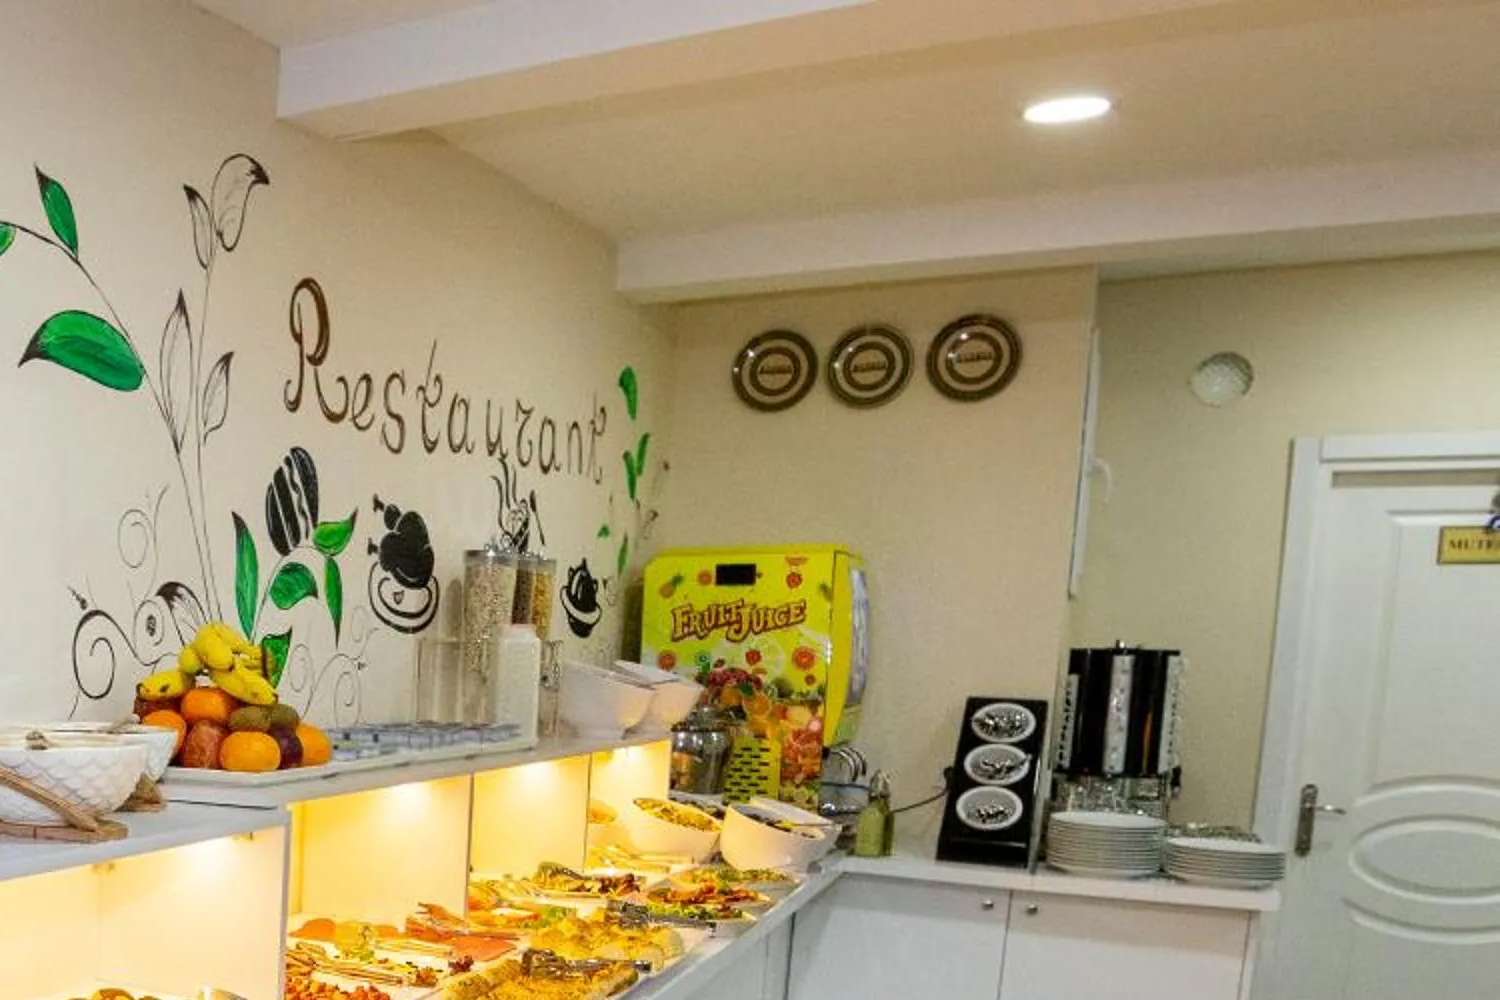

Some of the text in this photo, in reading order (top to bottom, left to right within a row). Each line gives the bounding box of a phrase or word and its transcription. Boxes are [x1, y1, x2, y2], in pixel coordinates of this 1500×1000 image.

[283, 276, 608, 485] Restaurant
[671, 597, 807, 643] FRUIT JUICE
